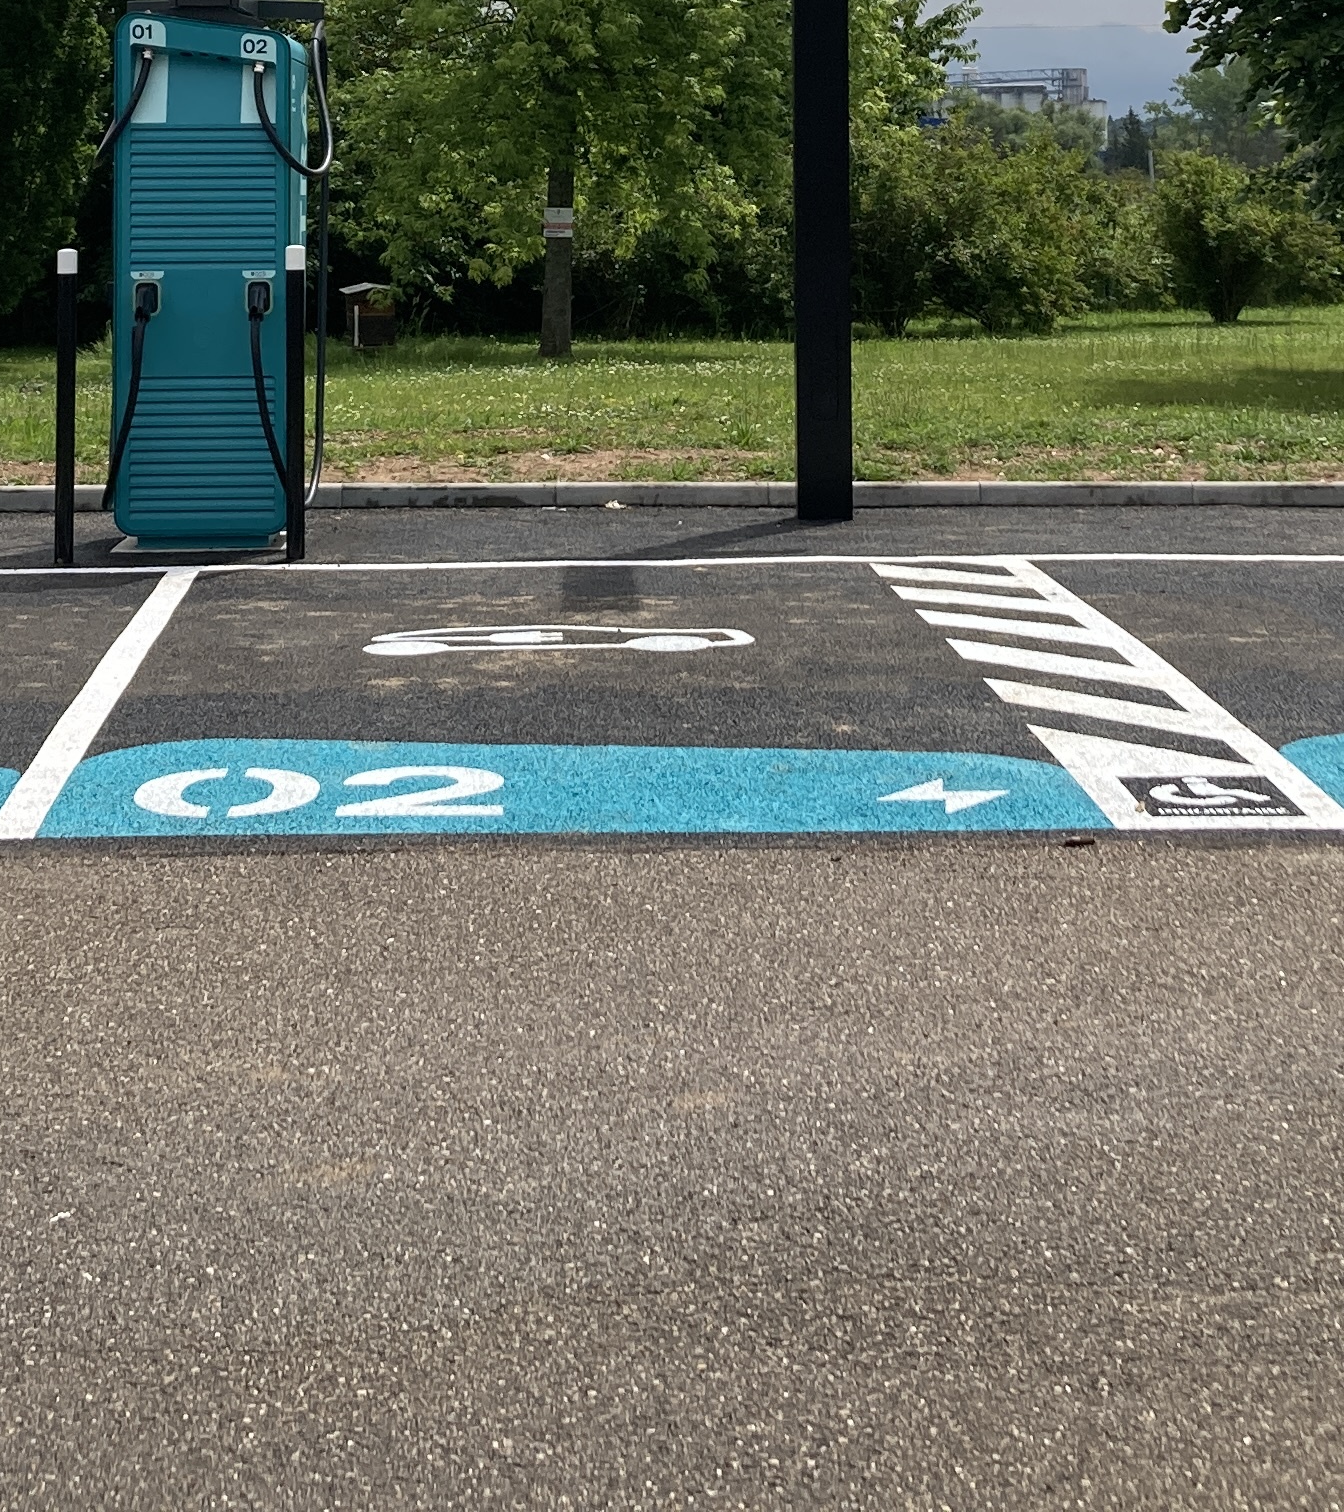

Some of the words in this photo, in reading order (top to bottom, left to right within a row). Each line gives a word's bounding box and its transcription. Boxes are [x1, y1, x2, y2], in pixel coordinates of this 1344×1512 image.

[132, 24, 153, 40] 01
[243, 38, 268, 54] 02
[133, 765, 504, 818] 02
